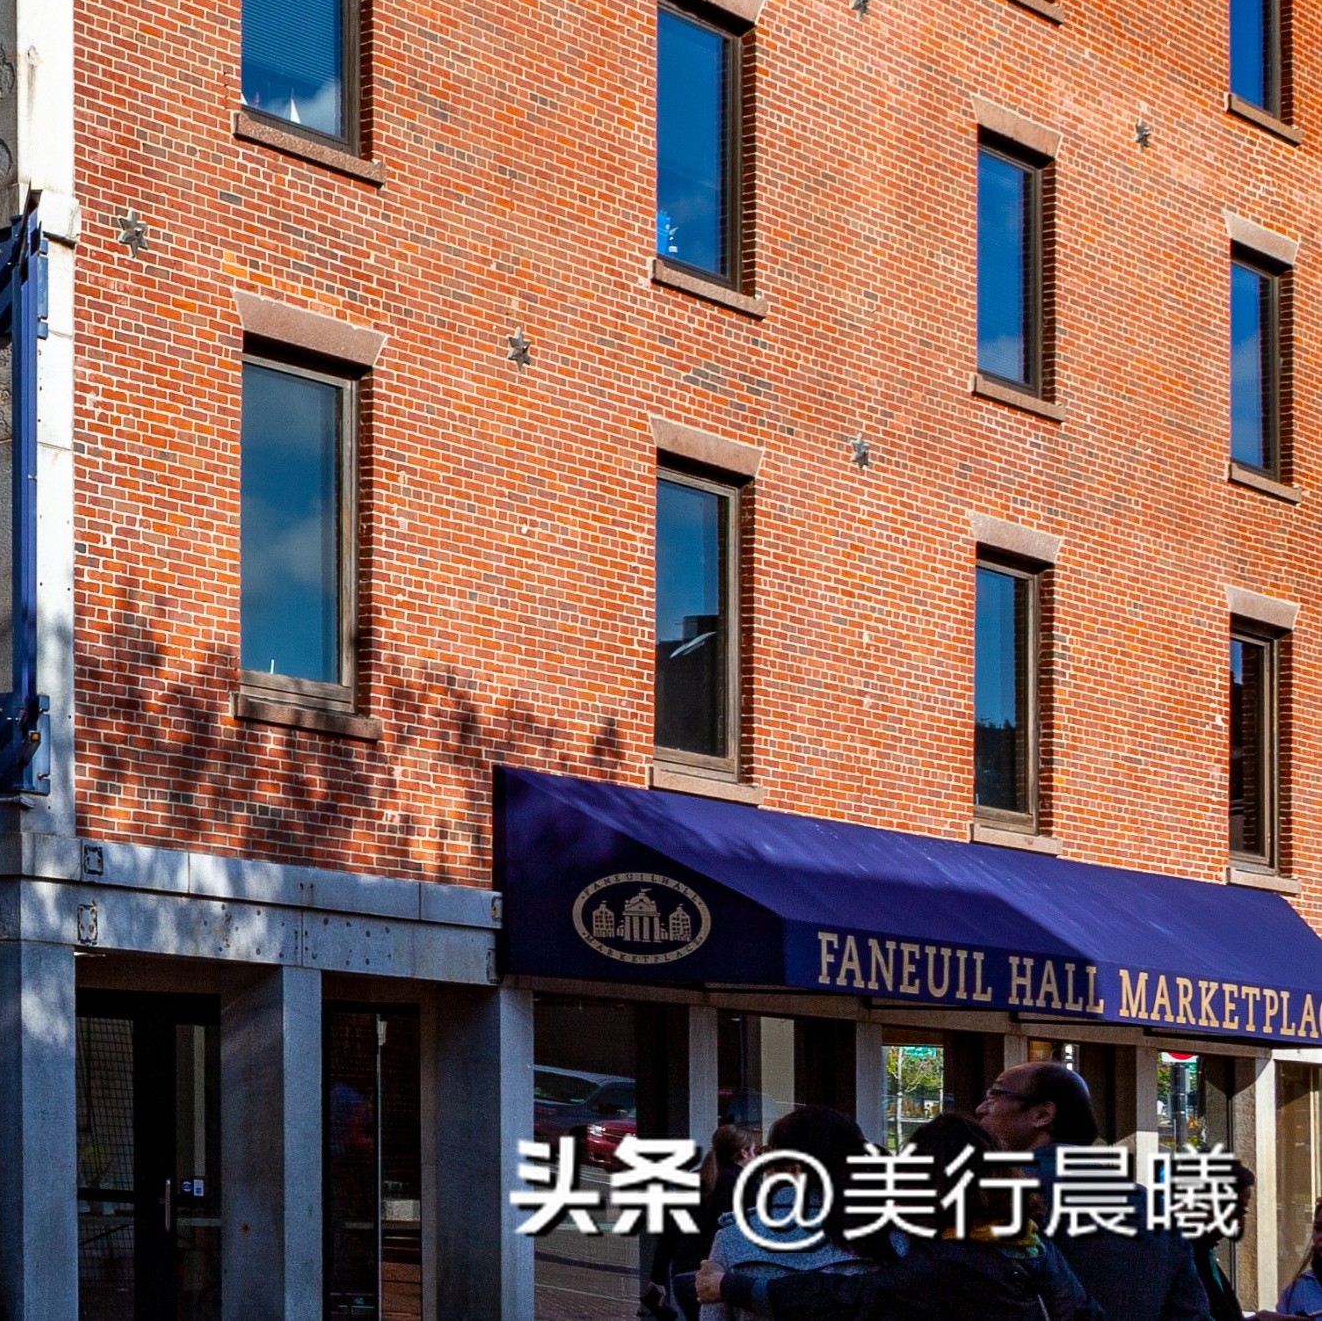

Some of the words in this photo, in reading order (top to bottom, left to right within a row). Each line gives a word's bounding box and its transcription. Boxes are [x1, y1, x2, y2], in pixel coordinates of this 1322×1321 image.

[583, 873, 658, 896] FANEUIL
[660, 877, 699, 902] HALL
[584, 935, 701, 963] MARKETPLACE
[817, 931, 992, 1001] FANEUIL
[1008, 955, 1104, 1014] HALL
[1119, 969, 1322, 1038] MARKETPLA
